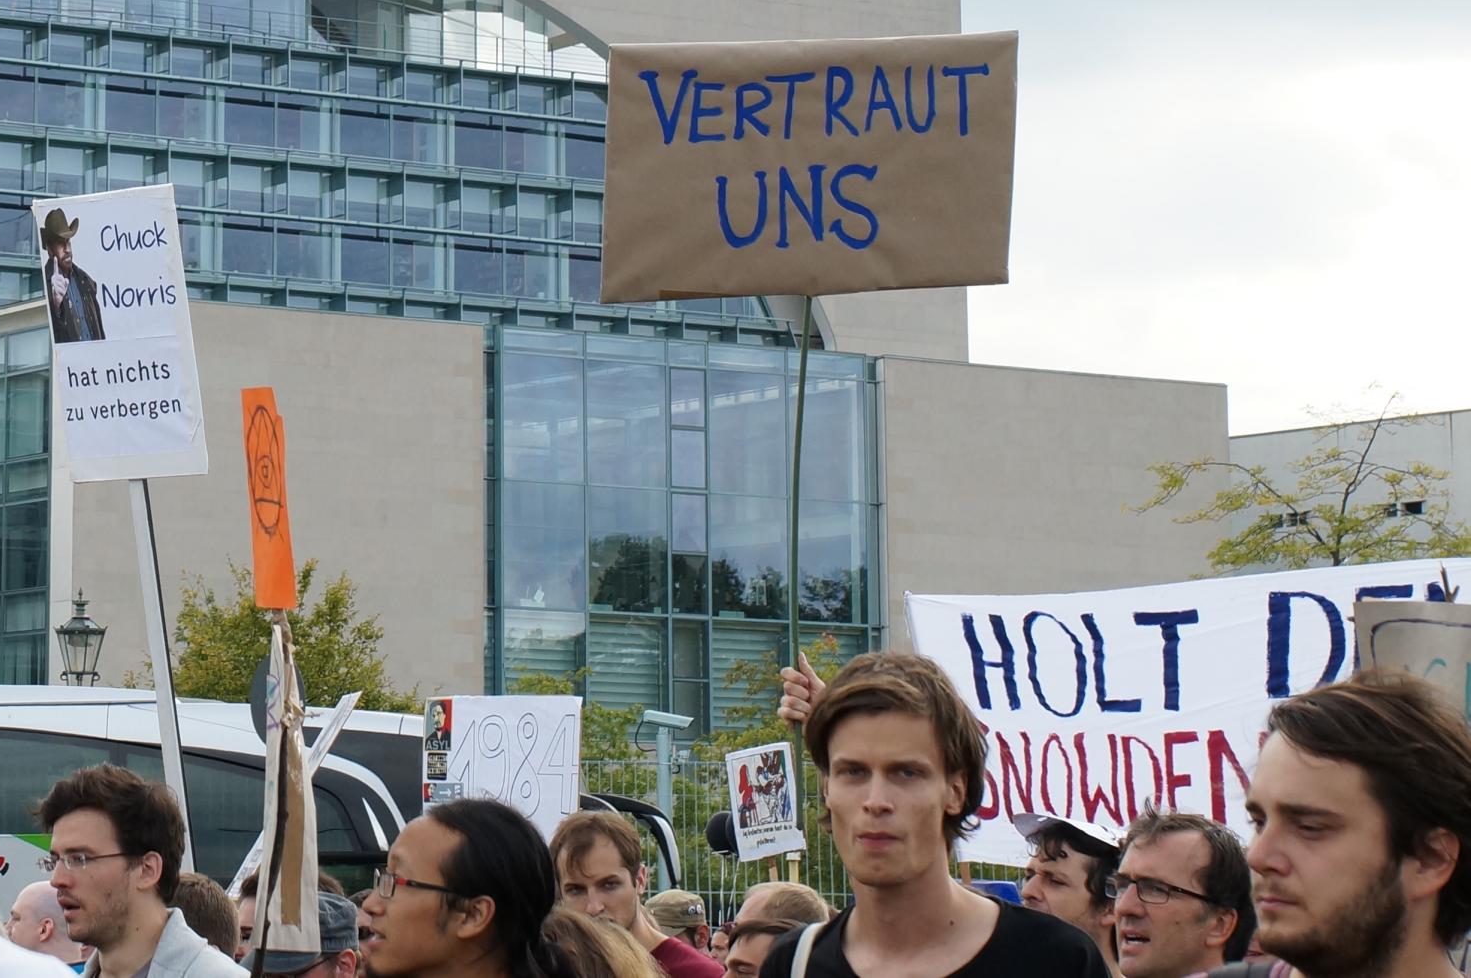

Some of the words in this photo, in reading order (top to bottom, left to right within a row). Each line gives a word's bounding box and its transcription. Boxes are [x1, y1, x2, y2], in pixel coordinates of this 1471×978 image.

[638, 63, 990, 145] VERTRAUT
[715, 163, 880, 251] UNS
[100, 221, 168, 252] Chuck
[101, 276, 177, 309] Norris
[67, 366, 99, 388] hat
[106, 360, 170, 385] nichts
[66, 406, 84, 422] zu
[89, 398, 182, 420] verbergen
[961, 608, 1199, 718] HOLT
[426, 739, 451, 751] ASYL
[448, 712, 579, 819] 1984
